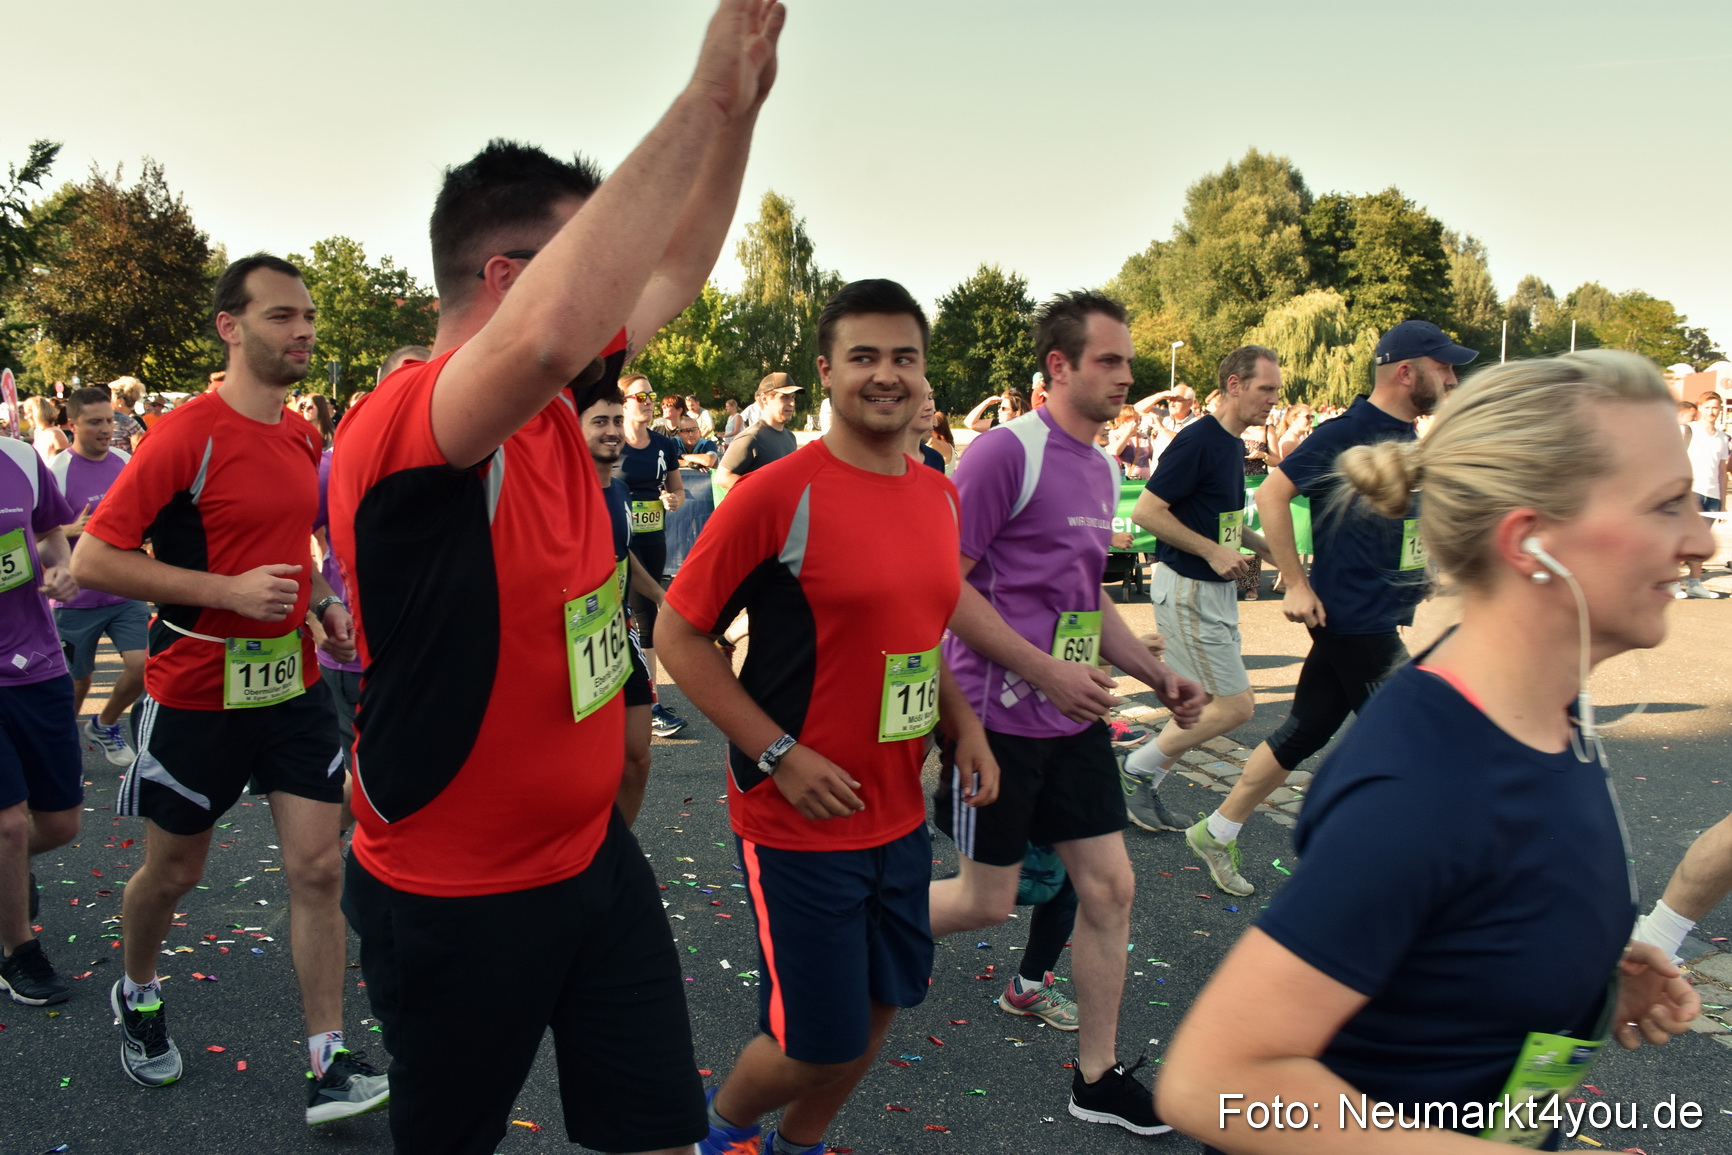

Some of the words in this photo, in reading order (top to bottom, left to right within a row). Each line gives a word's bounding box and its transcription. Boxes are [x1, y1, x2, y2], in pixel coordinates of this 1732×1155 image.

[635, 512, 661, 524] 1609
[0, 554, 16, 574] 5
[583, 611, 625, 678] 1162
[1064, 637, 1094, 663] 690
[239, 655, 296, 688] 1160
[897, 678, 936, 715] 116
